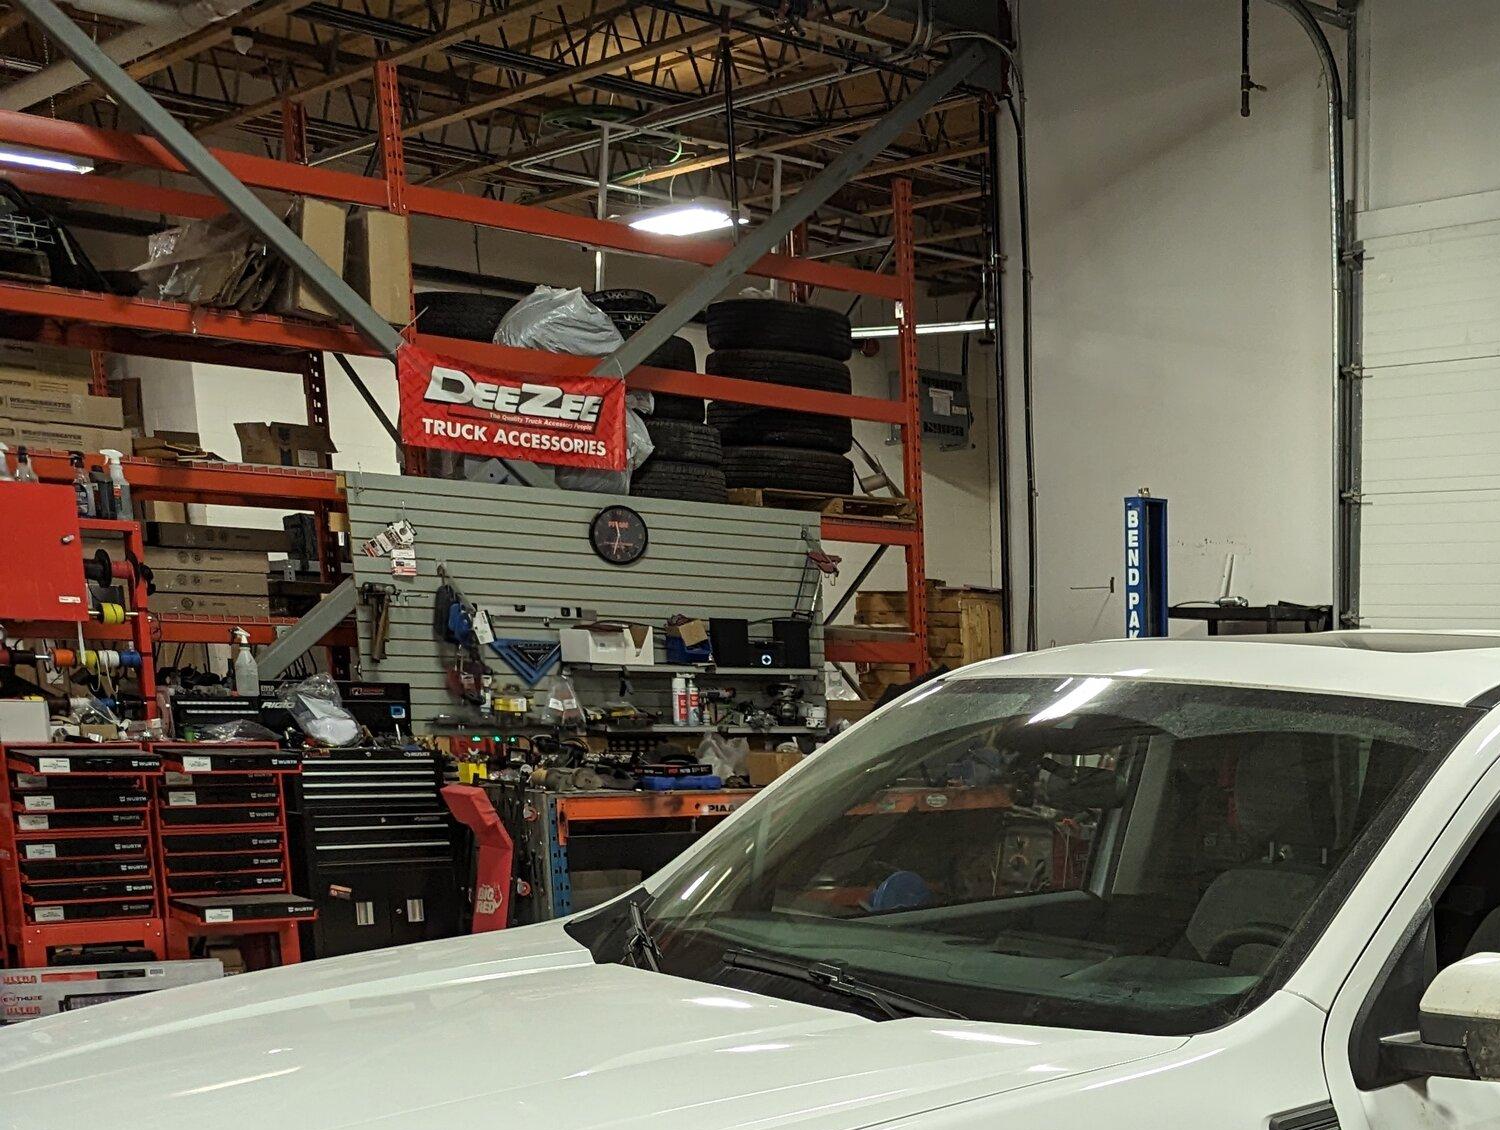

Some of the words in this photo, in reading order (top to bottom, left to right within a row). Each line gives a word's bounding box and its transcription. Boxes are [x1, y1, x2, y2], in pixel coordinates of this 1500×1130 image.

[502, 414, 523, 423] Quality
[525, 416, 543, 425] Truck
[422, 418, 487, 442] TRUCK
[493, 429, 606, 456] ACCESSORIES
